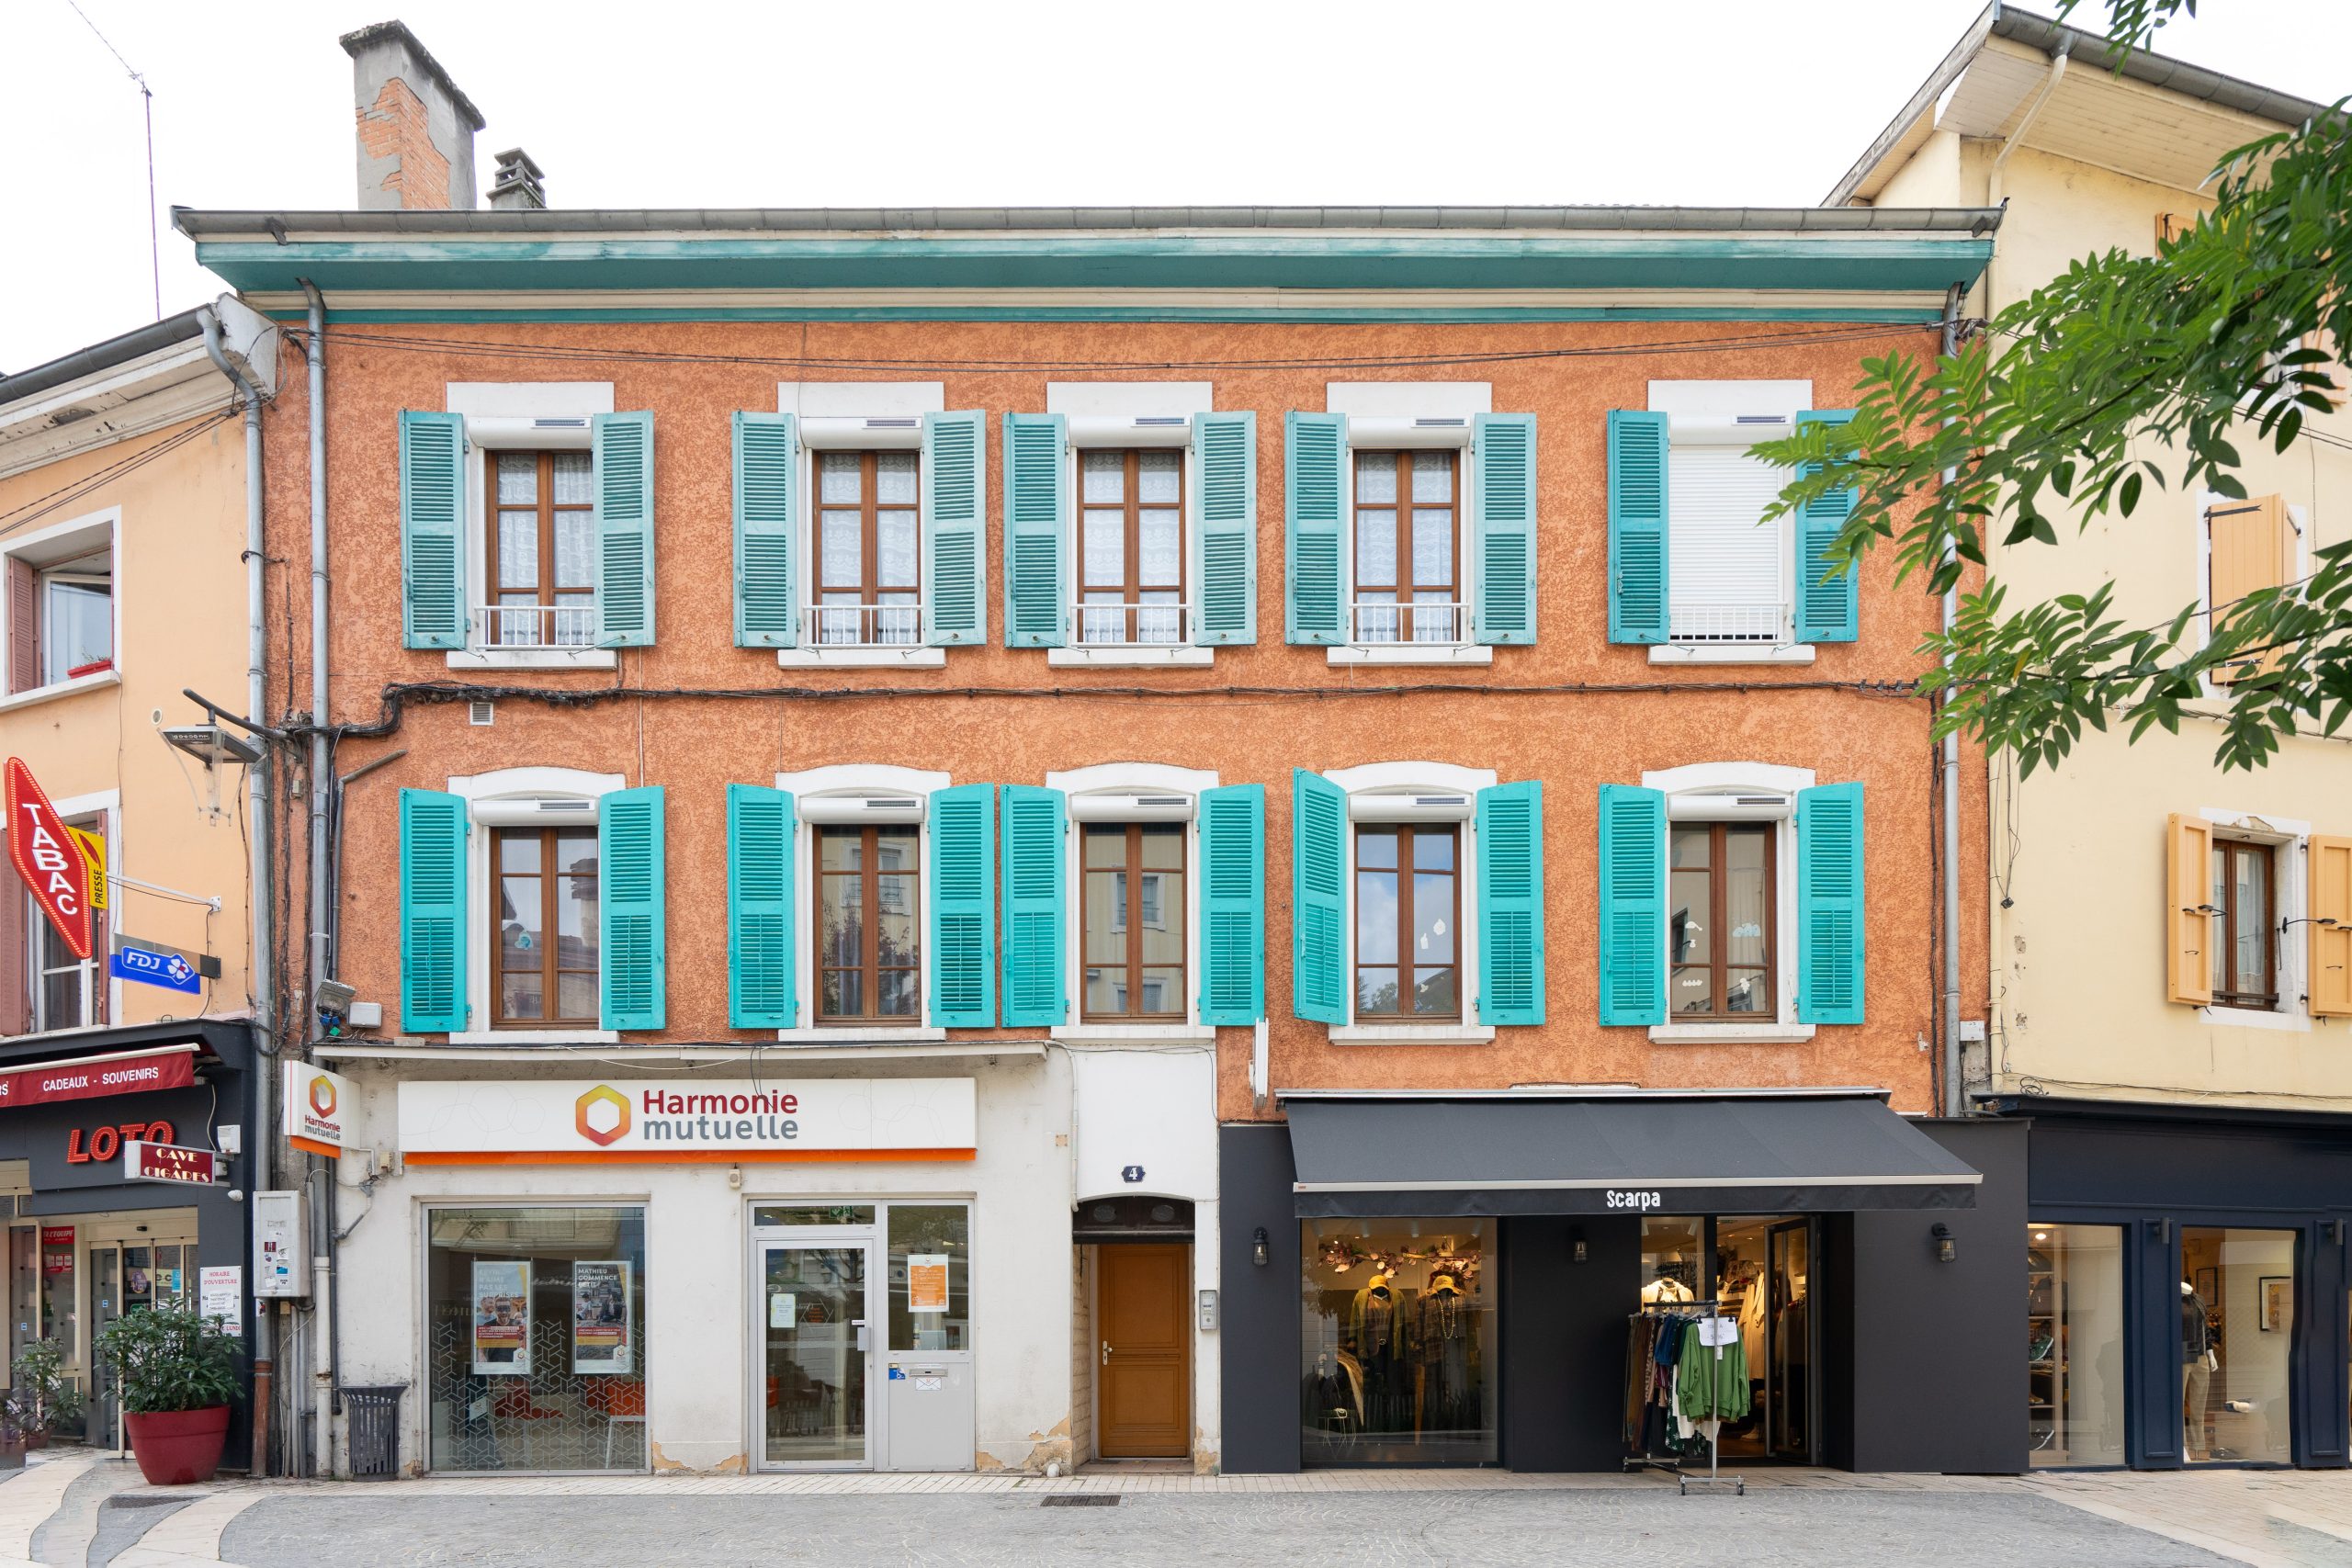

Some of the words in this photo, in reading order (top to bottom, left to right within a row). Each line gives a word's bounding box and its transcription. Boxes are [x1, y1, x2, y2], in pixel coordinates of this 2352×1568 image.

[22, 803, 78, 916] TABAC
[95, 869, 103, 905] PRESSE
[127, 952, 161, 970] FDJ
[43, 1076, 88, 1092] CADEAUX
[102, 1066, 159, 1085] SOUVENIRS
[643, 1089, 798, 1115] Harmonie
[304, 1114, 341, 1133] Harmonie
[304, 1124, 341, 1141] mutuelle
[643, 1115, 798, 1141] mutuelle
[67, 1120, 175, 1164] LOTO
[156, 1148, 198, 1163] CAVE
[172, 1161, 182, 1169] A
[143, 1166, 209, 1183] CIGARES
[1128, 1167, 1138, 1180] 4
[1606, 1190, 1661, 1212] Scarpa
